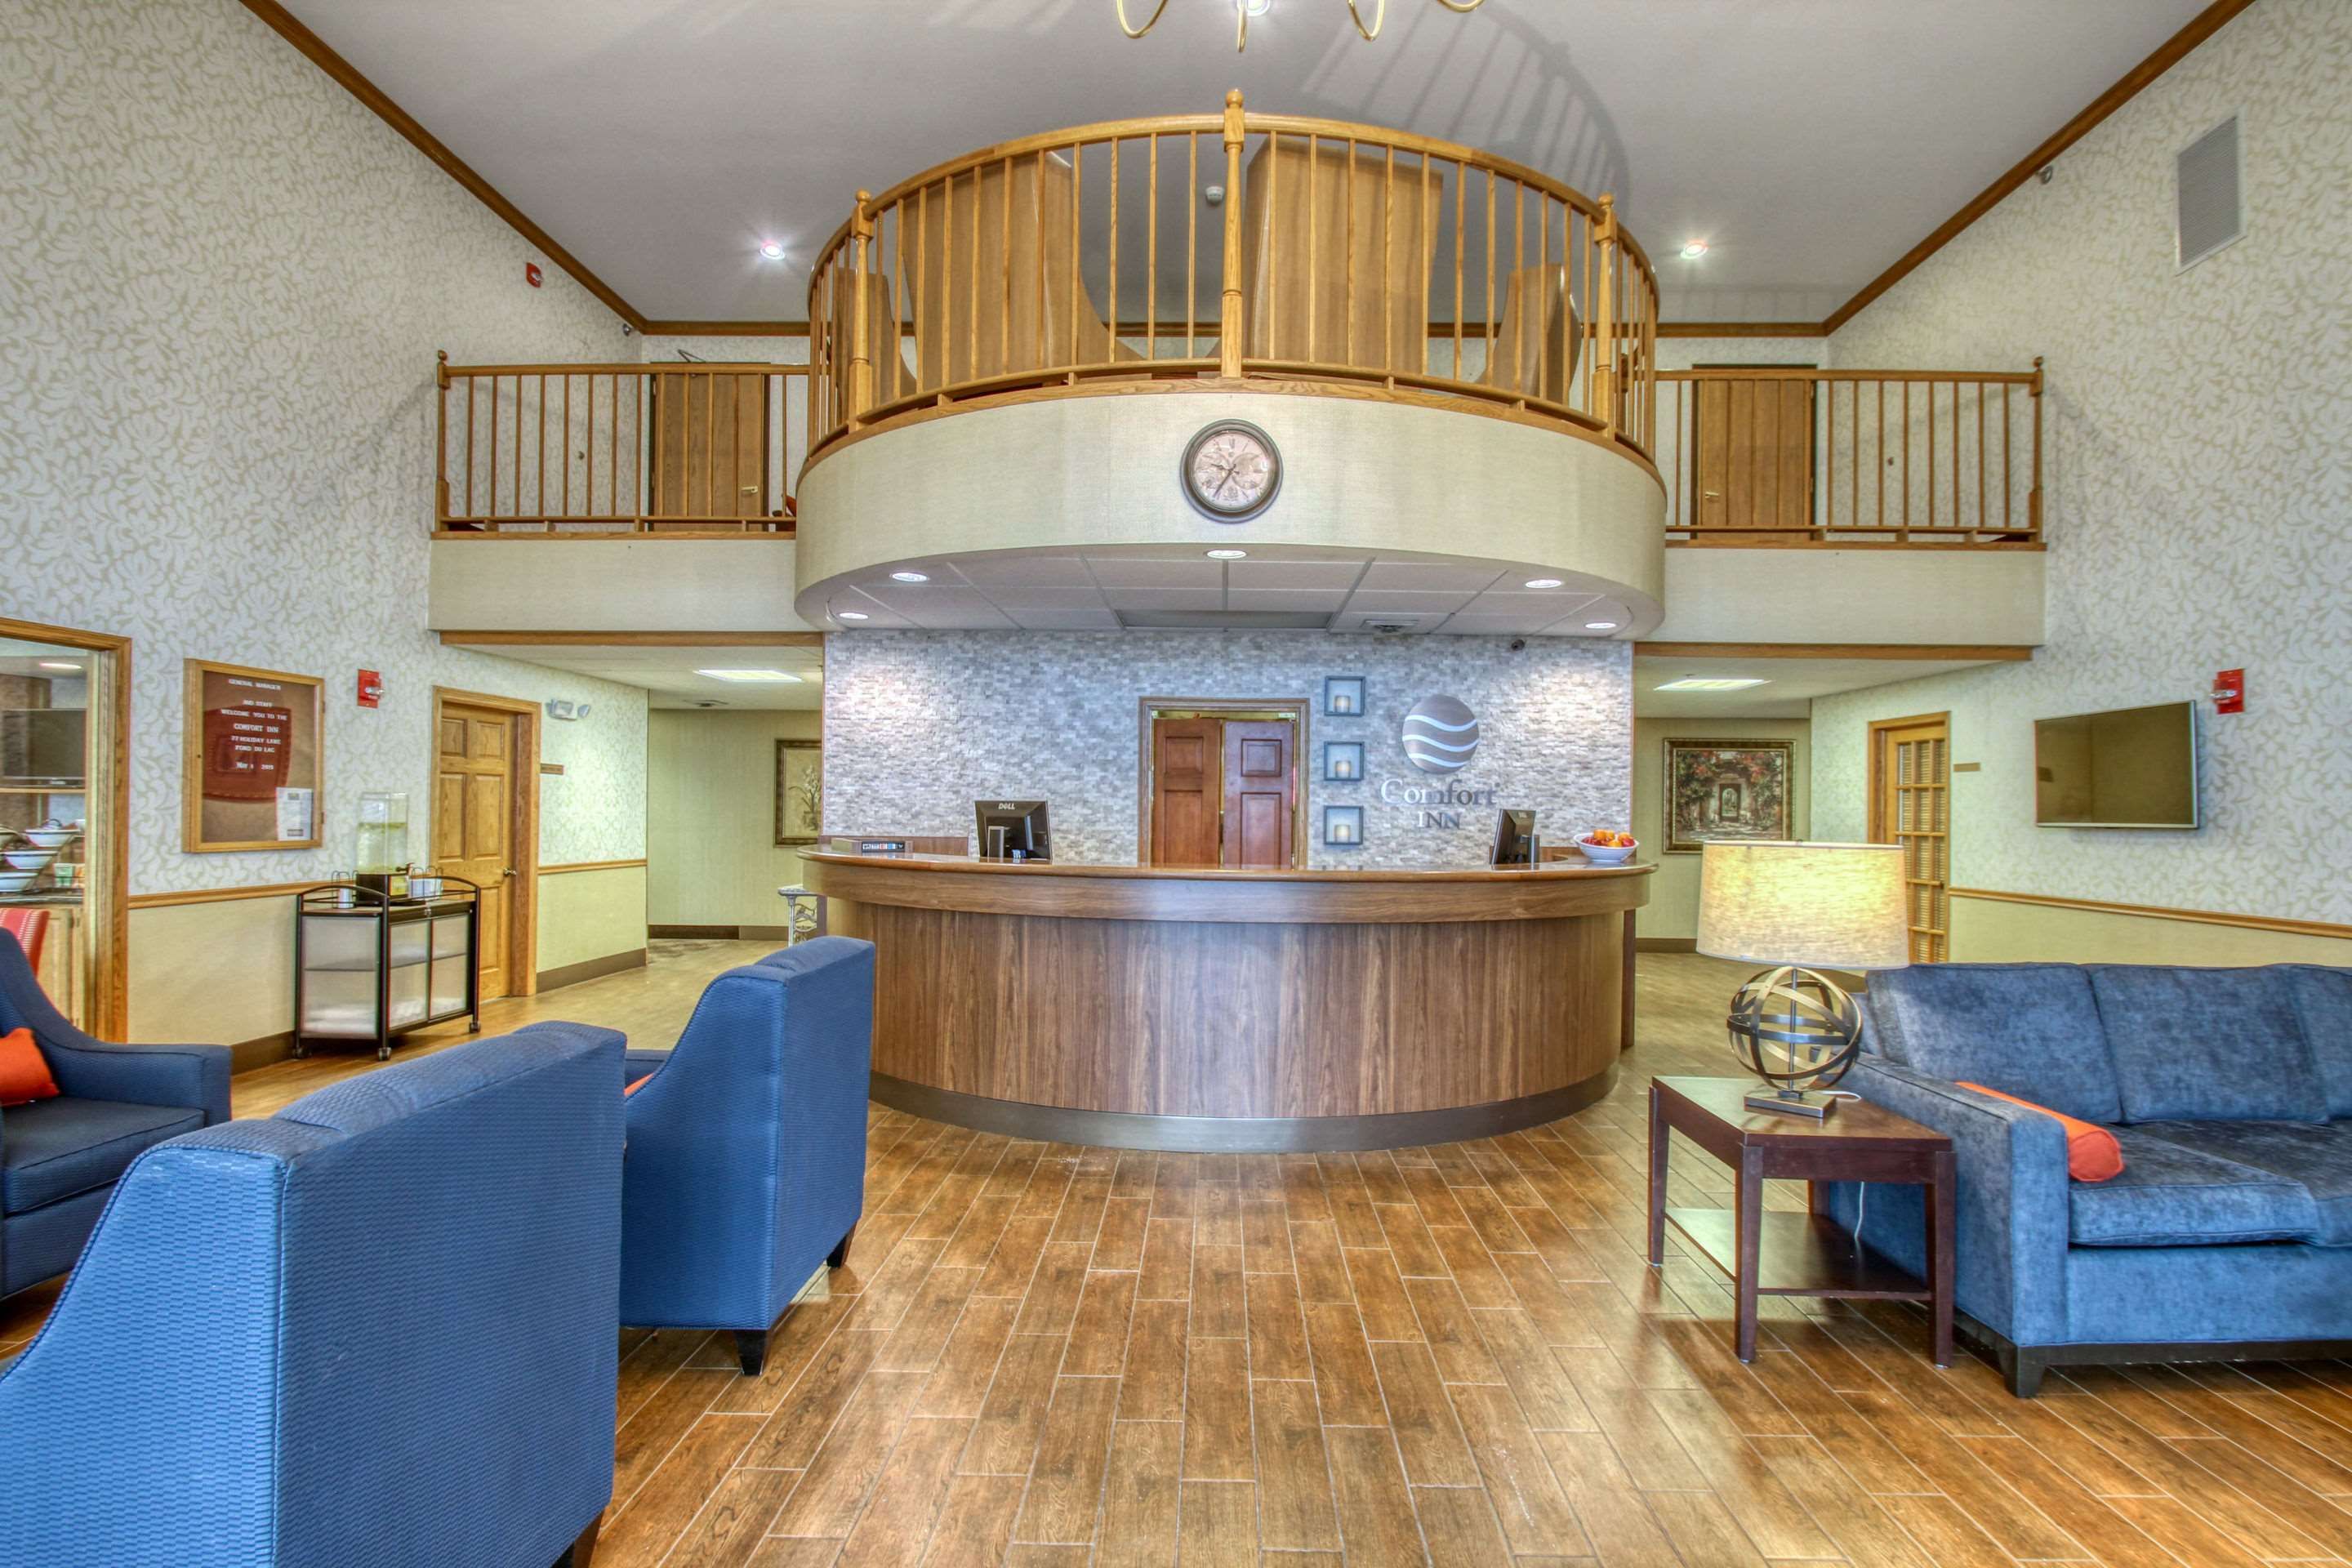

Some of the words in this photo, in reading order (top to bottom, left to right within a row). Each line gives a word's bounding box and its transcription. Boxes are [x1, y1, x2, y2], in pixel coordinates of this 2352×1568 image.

[221, 708, 249, 717] WELCOME
[234, 723, 264, 733] COMFORT
[1381, 778, 1498, 806] Comfort
[1417, 811, 1463, 831] INN
